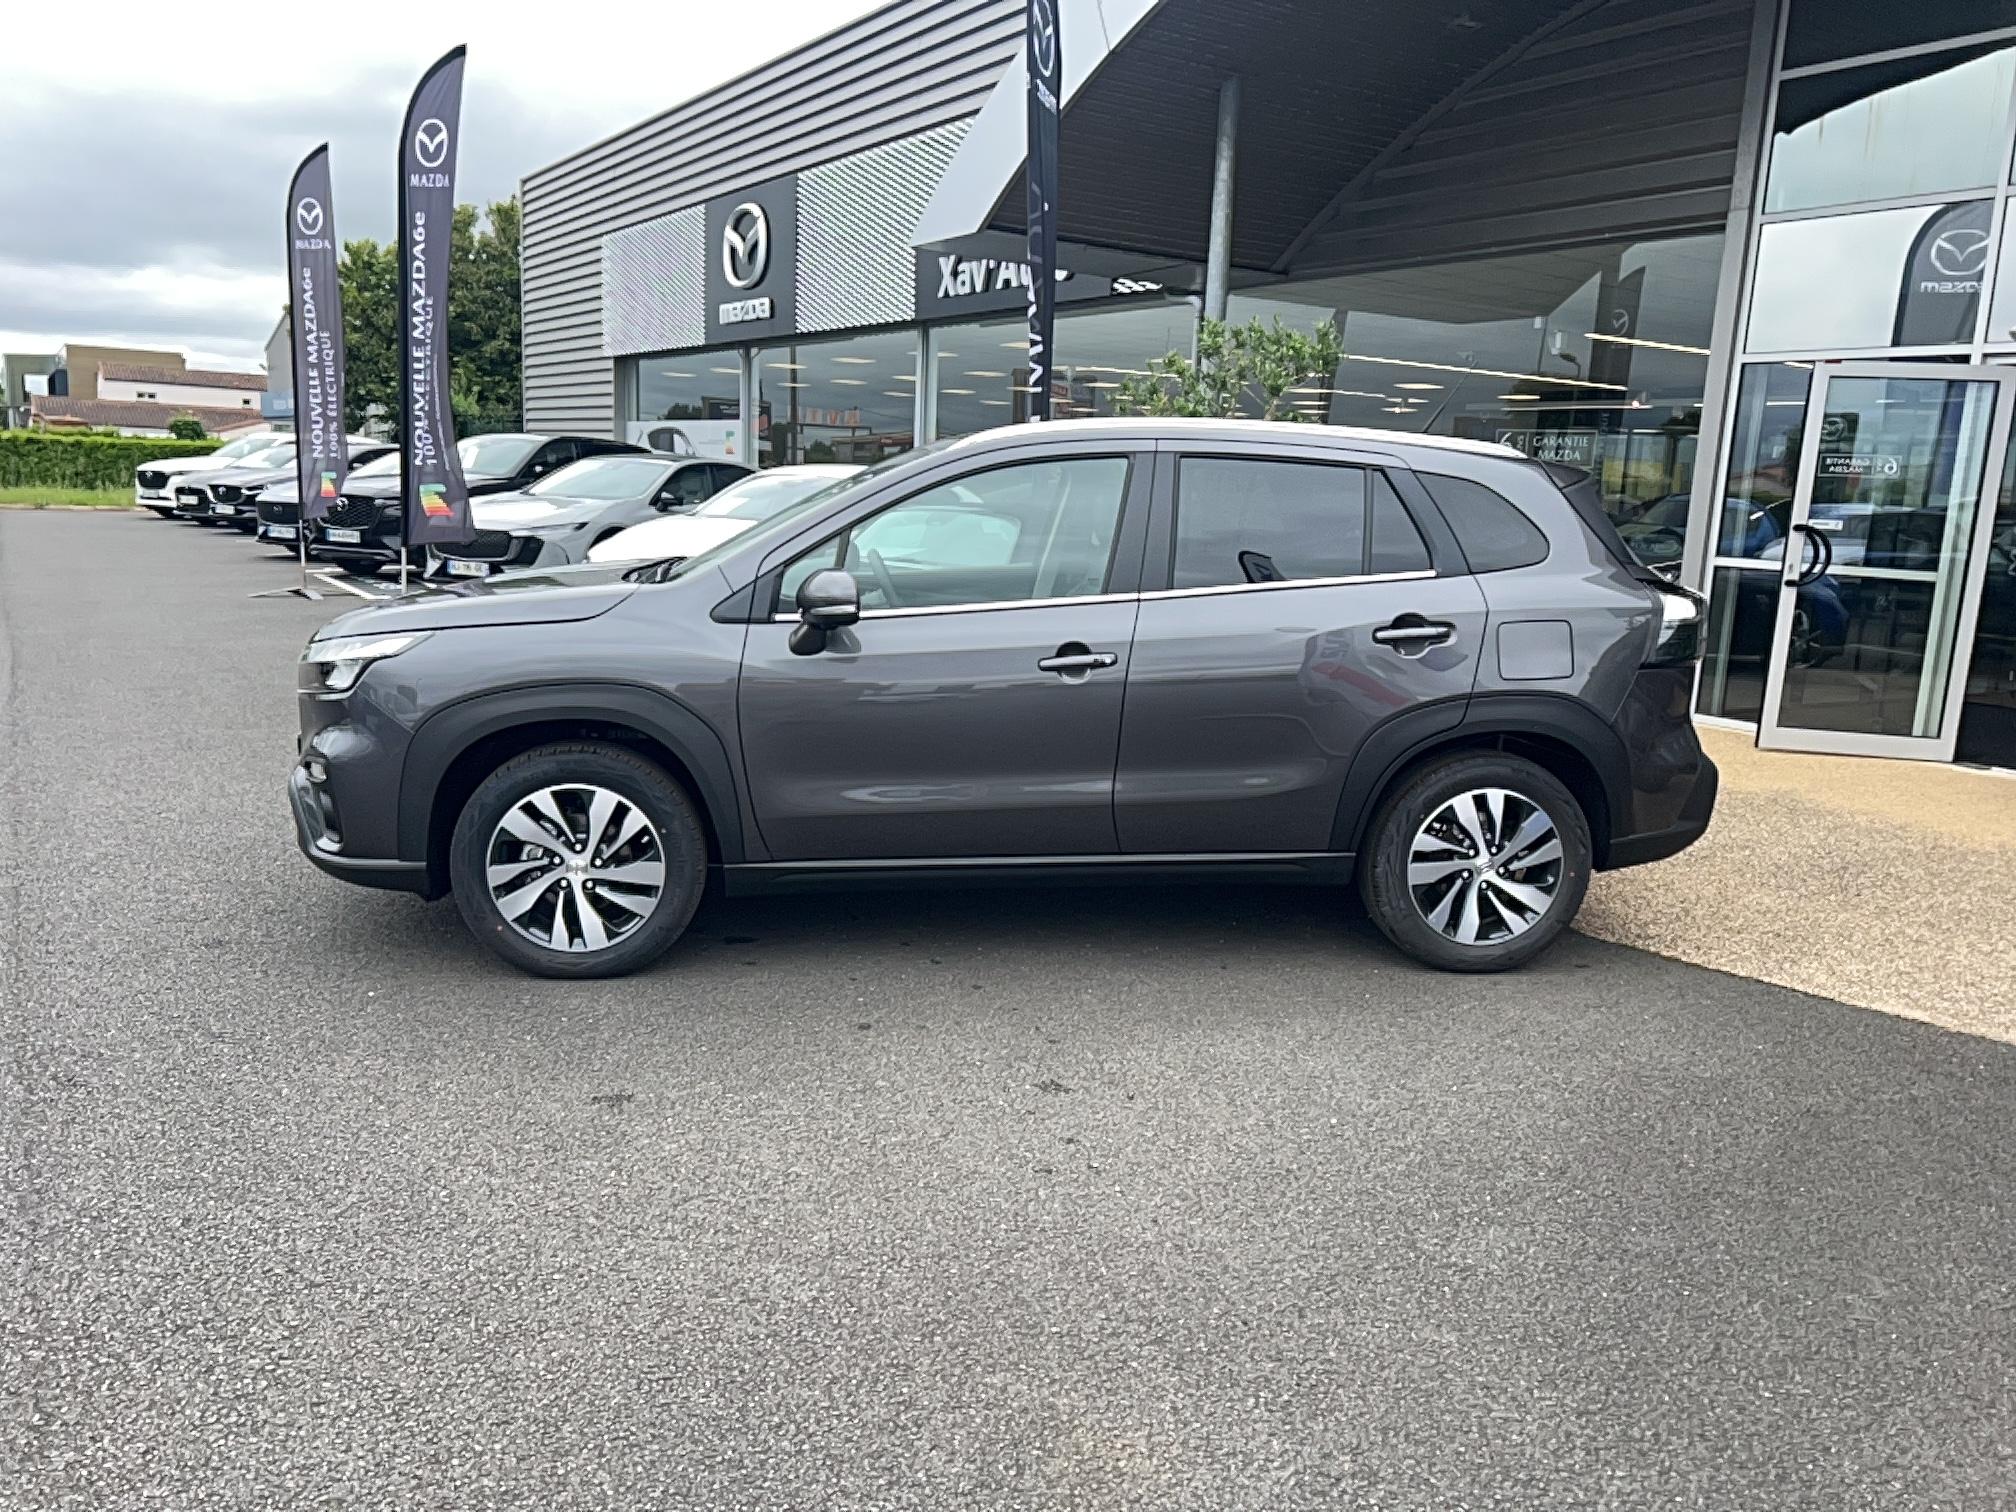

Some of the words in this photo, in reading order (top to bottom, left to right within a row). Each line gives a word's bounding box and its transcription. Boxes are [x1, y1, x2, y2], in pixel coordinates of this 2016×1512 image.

[410, 173, 450, 188] MAZDA
[295, 238, 331, 250] MAZDA
[308, 366, 325, 459] NOUVELLE
[411, 346, 427, 466] NOUVELLE
[1532, 436, 1590, 447] GARANTIE
[1536, 450, 1581, 460] MAZDA
